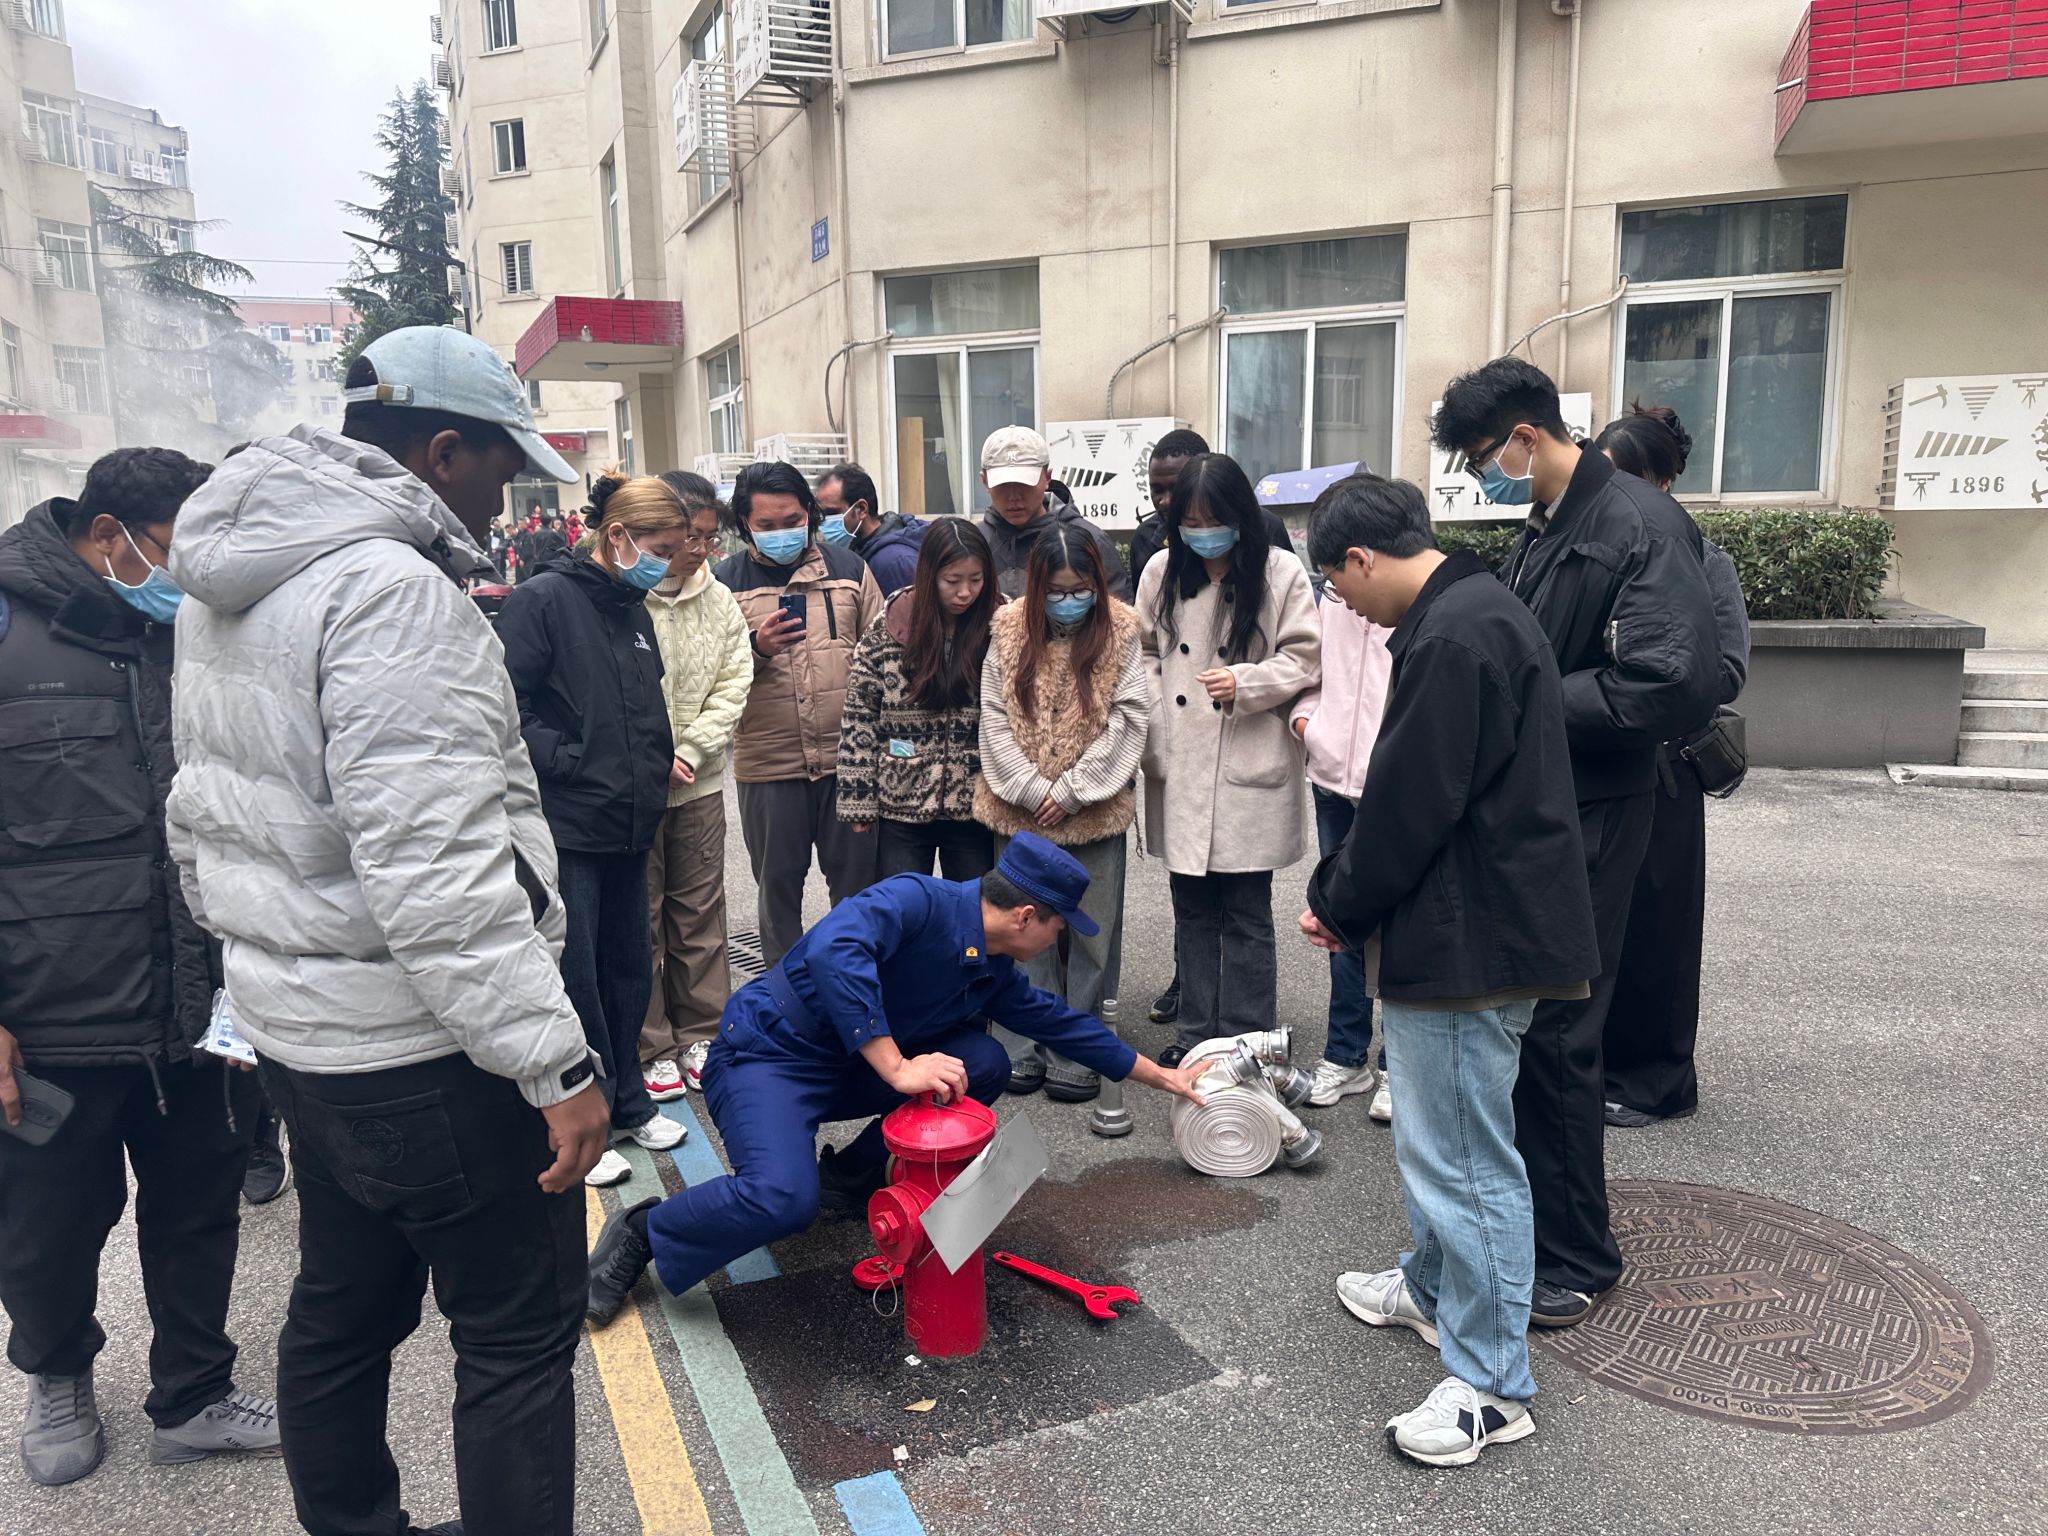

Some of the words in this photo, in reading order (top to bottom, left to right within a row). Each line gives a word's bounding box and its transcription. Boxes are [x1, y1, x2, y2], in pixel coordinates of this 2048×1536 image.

[1949, 476, 2005, 494] 1896
[1082, 503, 1118, 518] 1896
[1670, 1277, 1763, 1301] 雨水
